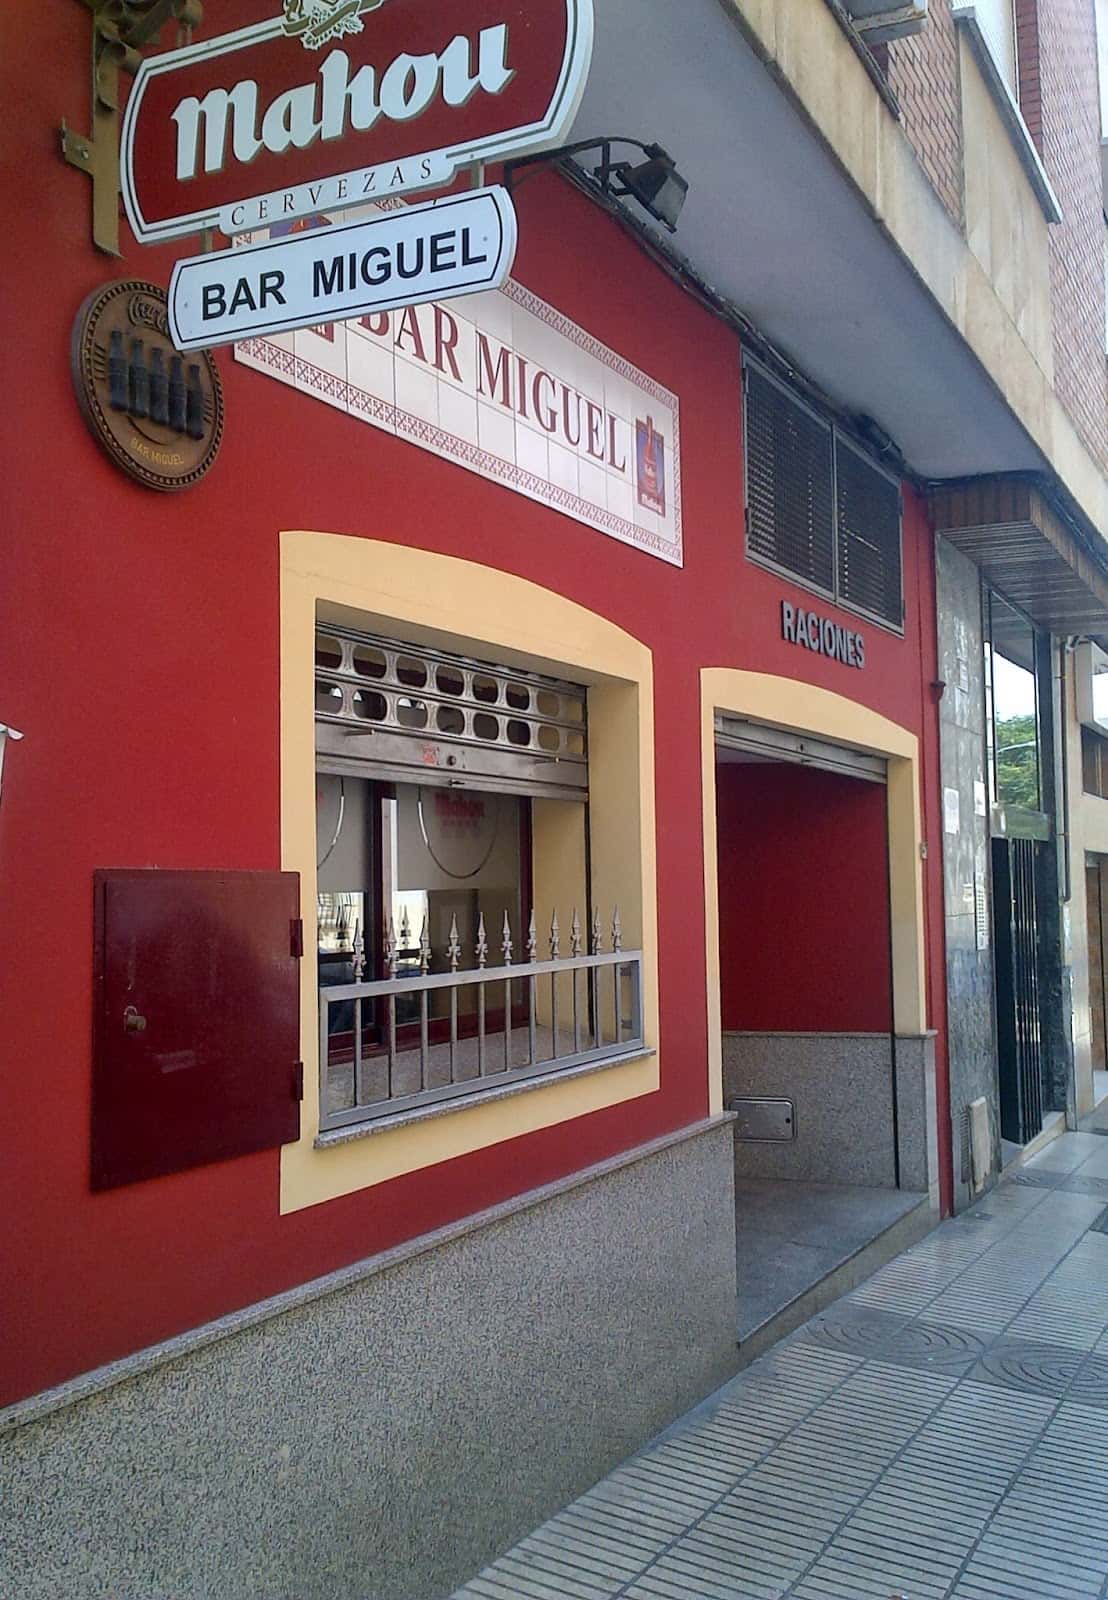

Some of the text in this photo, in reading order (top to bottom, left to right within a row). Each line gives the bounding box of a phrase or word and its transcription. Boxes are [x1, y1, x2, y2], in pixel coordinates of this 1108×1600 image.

[171, 23, 514, 181] Mahou
[231, 158, 434, 227] CERVEZAS
[201, 270, 287, 321] BAR
[313, 227, 488, 295] MIGUEL
[475, 329, 627, 473] MIGUEL
[780, 600, 865, 669] RACIONES
